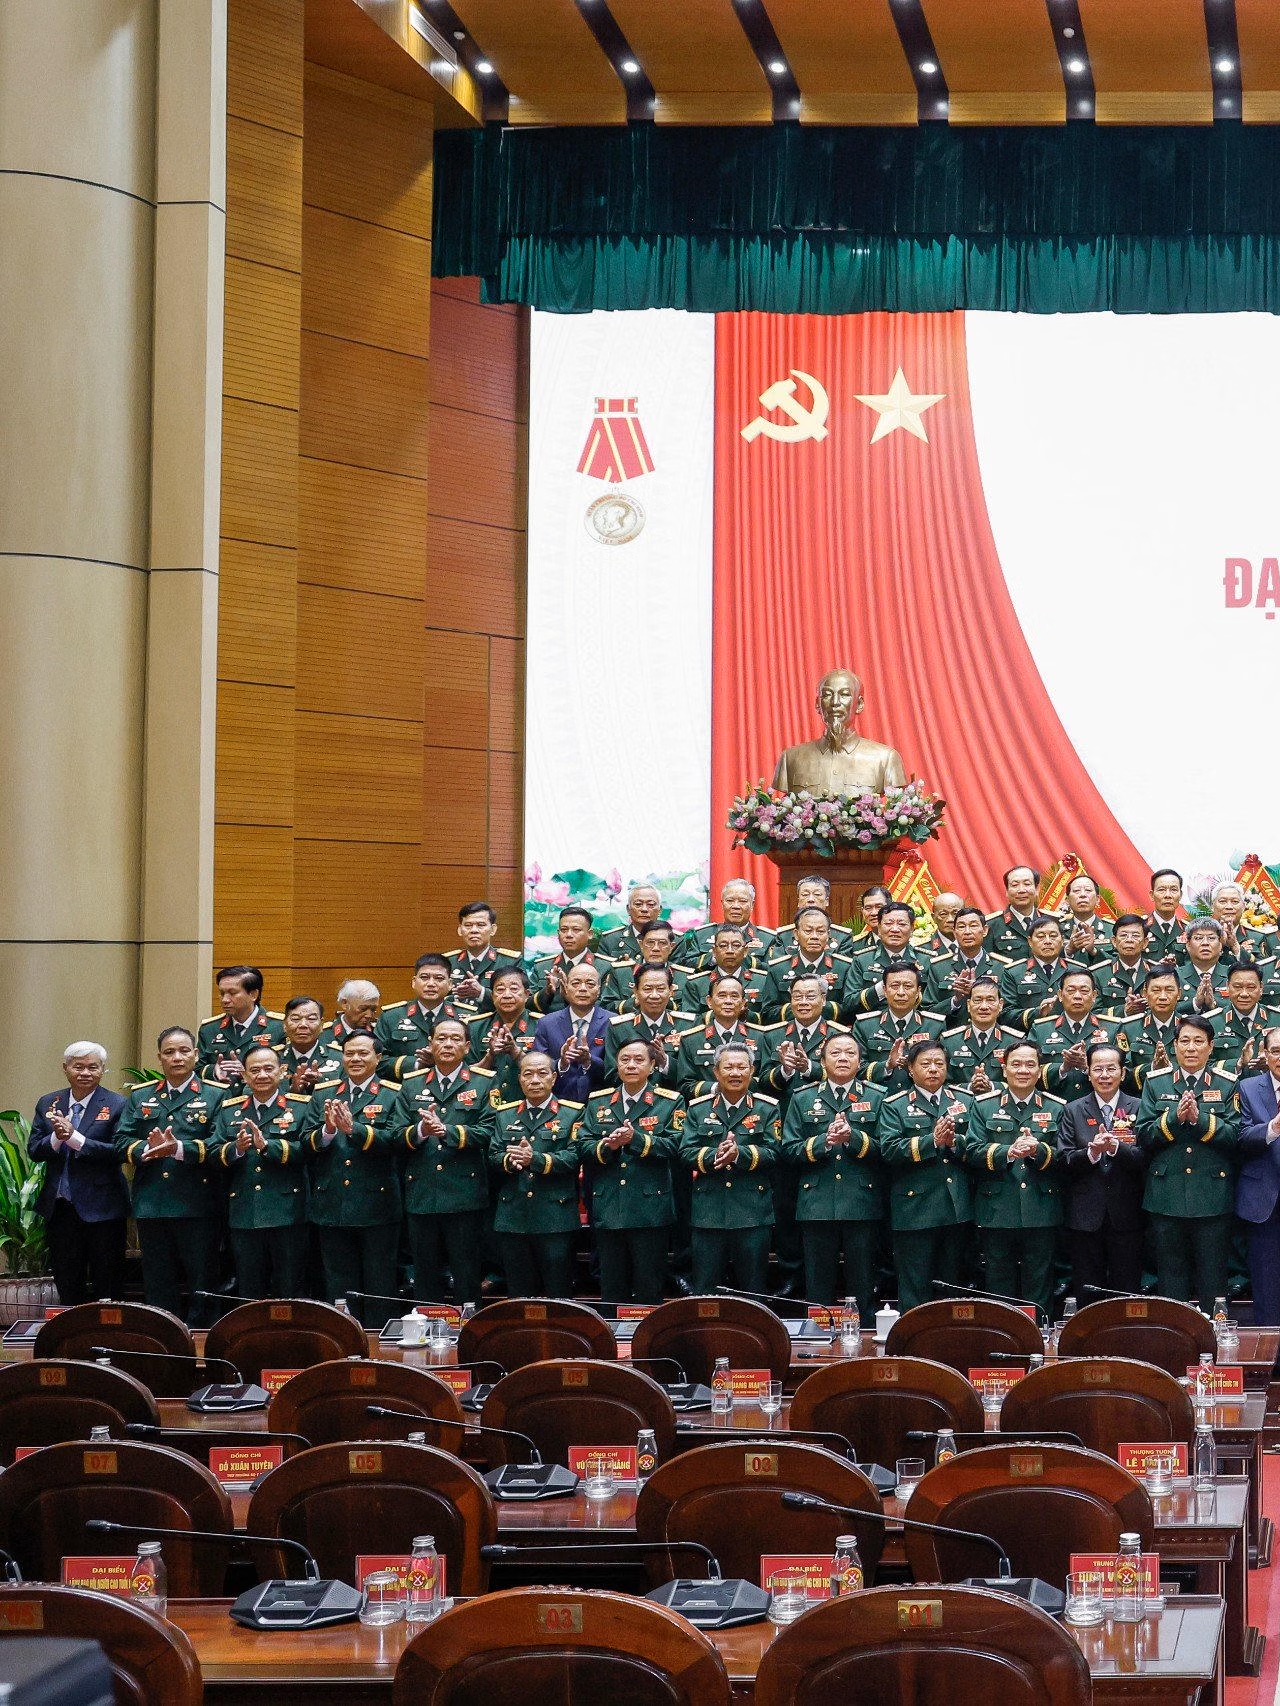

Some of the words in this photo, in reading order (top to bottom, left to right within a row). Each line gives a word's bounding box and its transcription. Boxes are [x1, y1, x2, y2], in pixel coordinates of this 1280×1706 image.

[878, 1368, 894, 1382] 03
[92, 1455, 110, 1470] 07
[355, 1455, 375, 1471] 05
[752, 1456, 771, 1473] 03
[1126, 1457, 1138, 1468] LÊ
[92, 1567, 106, 1575] ĐẠI
[108, 1564, 126, 1574] BIỂU
[545, 1606, 573, 1628] 03
[909, 1604, 932, 1627] 01
